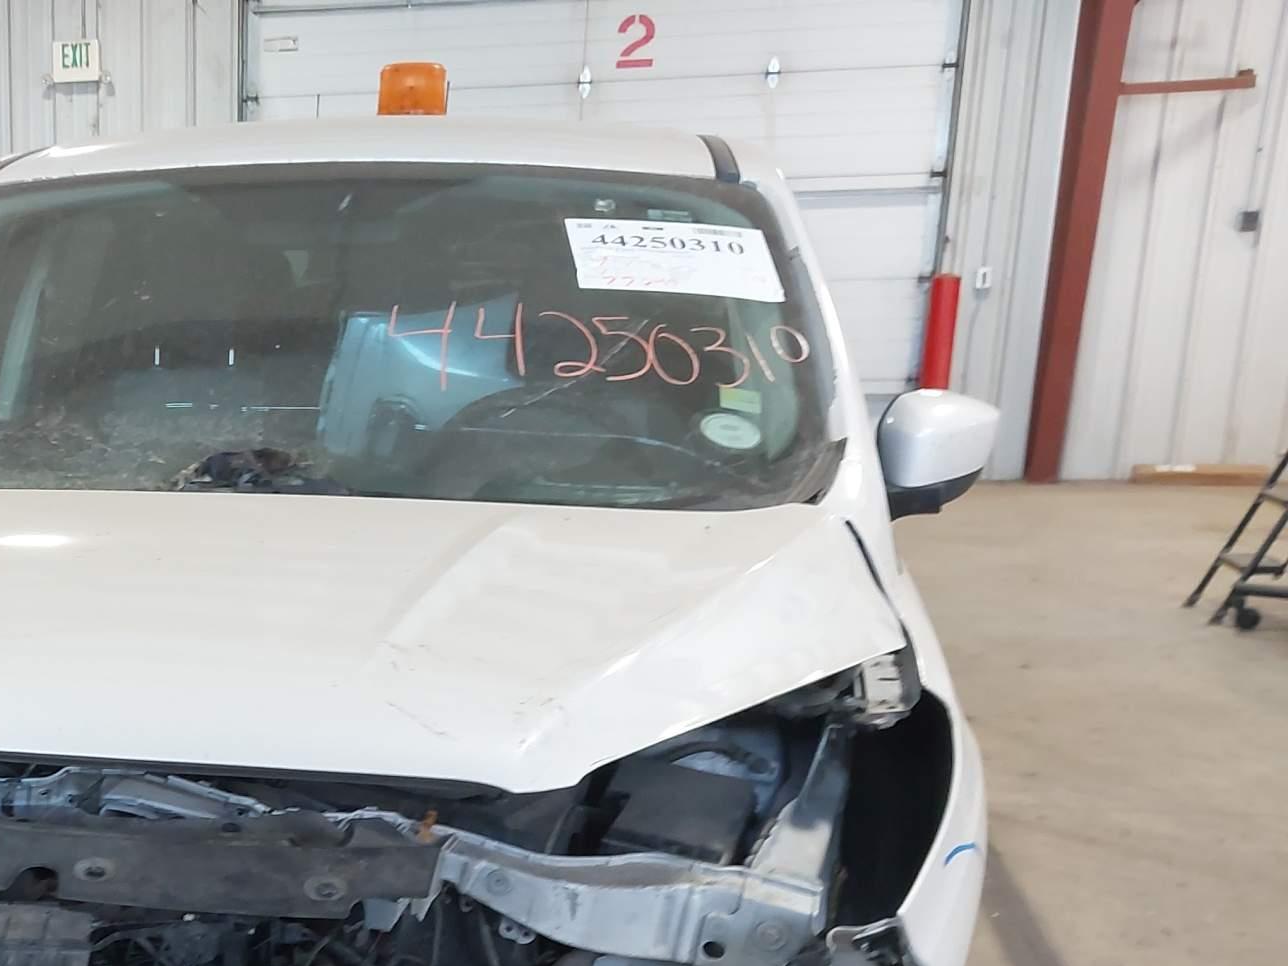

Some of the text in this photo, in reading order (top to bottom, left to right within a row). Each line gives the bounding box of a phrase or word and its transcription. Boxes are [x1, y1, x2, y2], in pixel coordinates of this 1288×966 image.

[62, 43, 90, 68] EXIT
[616, 14, 655, 69] 2
[591, 233, 745, 256] 44250310
[386, 301, 810, 391] 44250310
